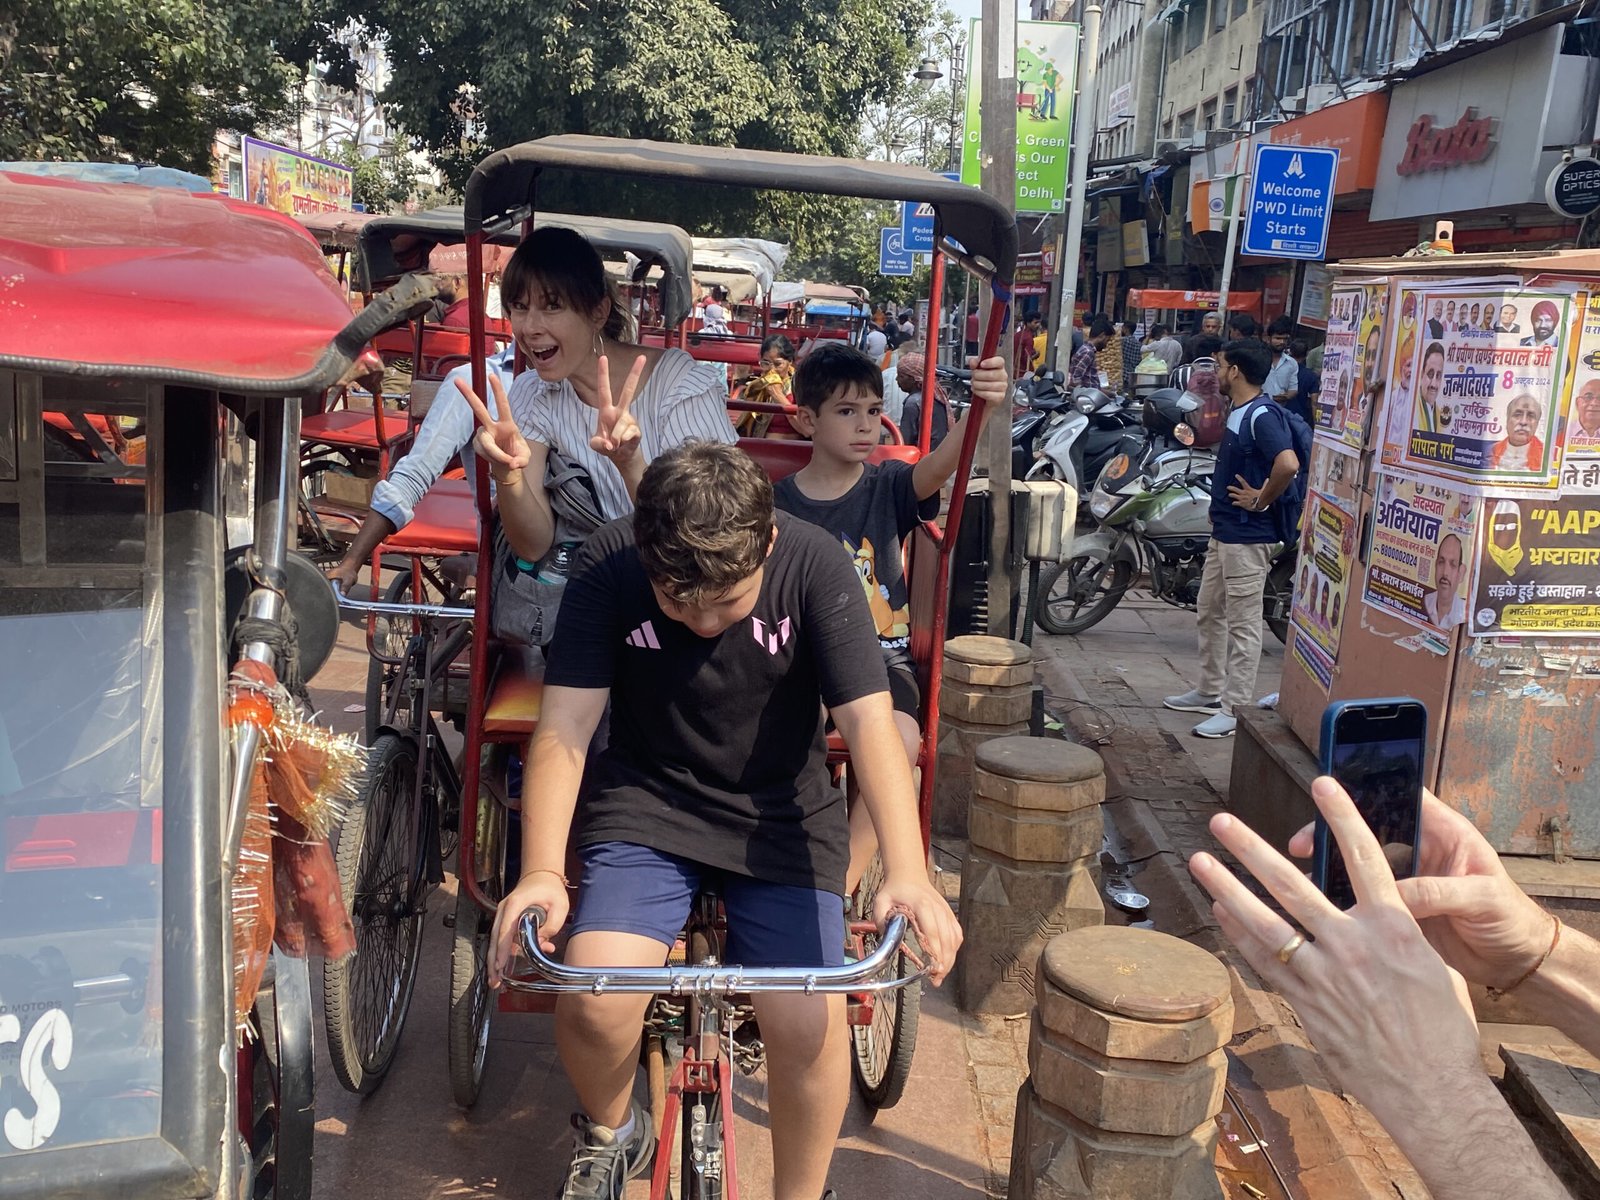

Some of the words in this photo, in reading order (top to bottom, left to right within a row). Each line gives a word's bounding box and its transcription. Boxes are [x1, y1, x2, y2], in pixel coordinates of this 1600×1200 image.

[1025, 134, 1065, 147] Green
[1396, 106, 1496, 176] Bata
[1031, 152, 1056, 164] Our
[1563, 170, 1600, 182] SUPER
[1020, 186, 1054, 199] Delhi
[1262, 182, 1321, 199] Welcome
[1562, 180, 1600, 192] OPTICS
[1255, 201, 1287, 215] PWD
[1291, 203, 1324, 218] Limit
[912, 226, 934, 235] Pedes
[1265, 221, 1306, 236] Starts
[1447, 342, 1456, 362] श्री
[1455, 344, 1475, 364] प्रवीण
[1533, 345, 1553, 367] जी
[1442, 366, 1499, 397] जन्मदिवस
[1502, 370, 1514, 390] 8
[1535, 377, 1551, 386] 2024
[1460, 402, 1494, 419] हार्दिक
[1411, 432, 1438, 458] गोपाल
[1439, 437, 1455, 461] गर्ग
[1413, 494, 1445, 516] सदस्यता
[1377, 498, 1442, 545] अभियान
[1488, 581, 1517, 600] सड़के
[1518, 580, 1535, 603] हुई
[1536, 585, 1587, 599] खस्ताहाल
[1509, 606, 1541, 616] भारतीय
[1543, 608, 1569, 616] जनता
[1510, 618, 1538, 628] गोपाल
[1562, 618, 1583, 628] प्रदेश
[11, 1000, 63, 1014] MOTORS
